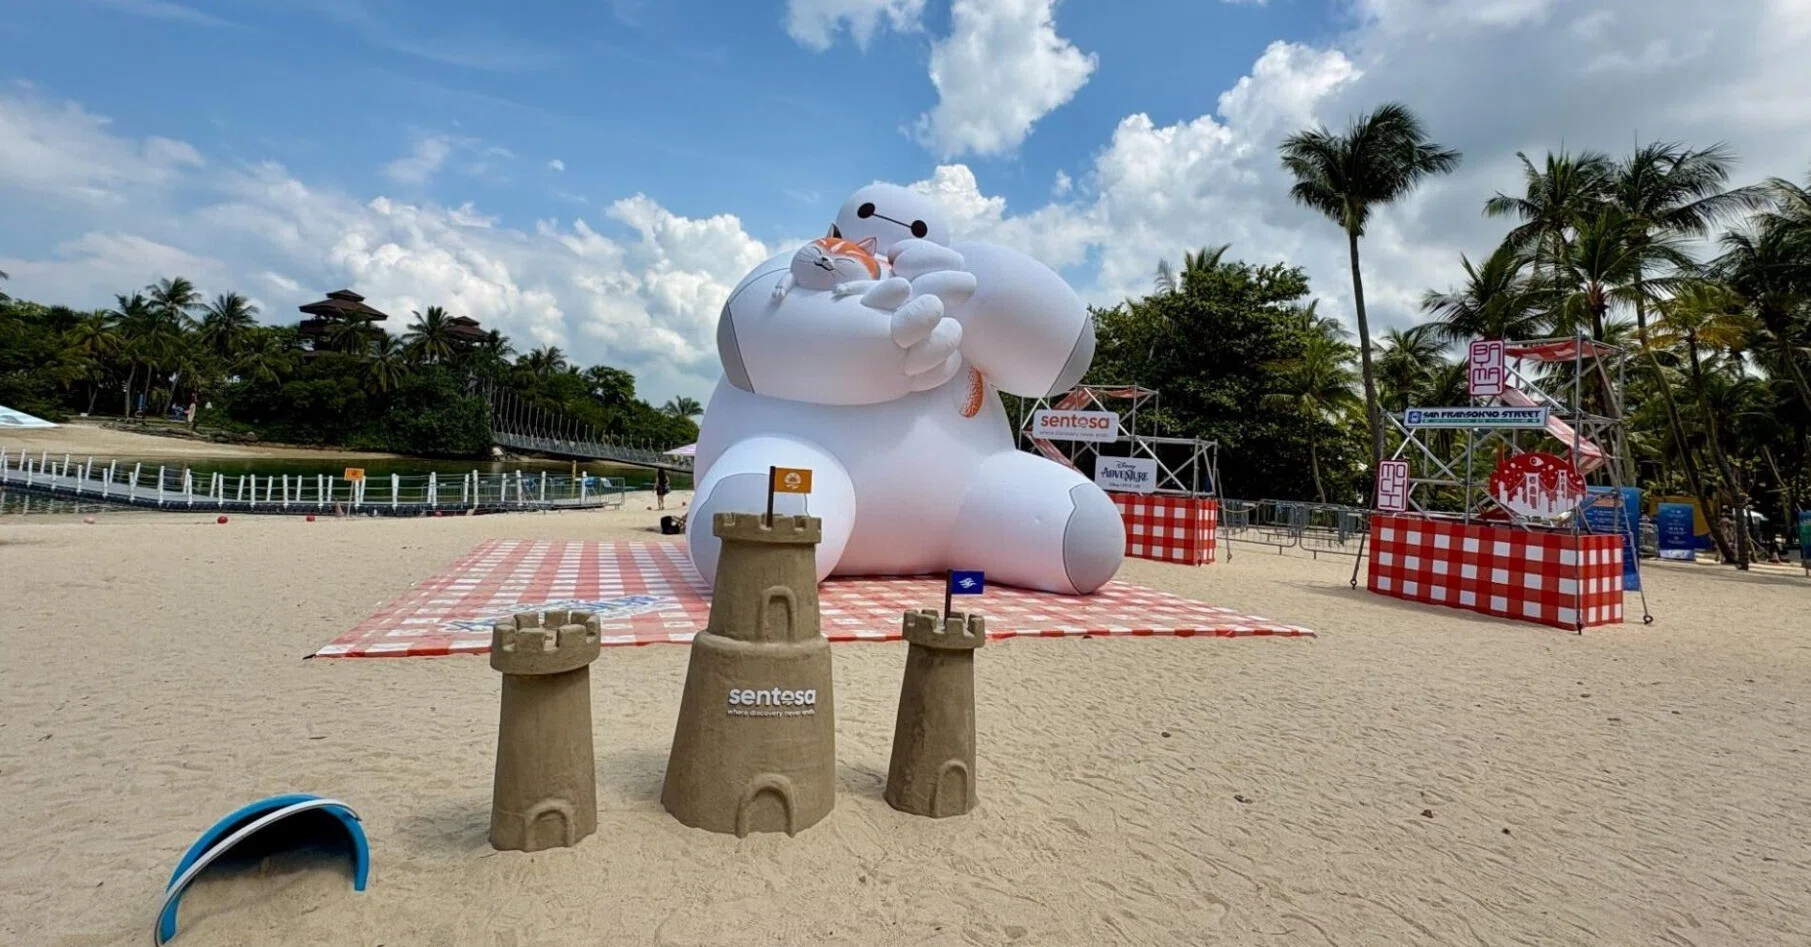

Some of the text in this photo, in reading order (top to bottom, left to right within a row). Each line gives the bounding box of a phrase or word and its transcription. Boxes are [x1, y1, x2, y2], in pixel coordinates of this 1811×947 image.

[1040, 414, 1110, 429] sentosa
[1502, 410, 1540, 418] STREET
[728, 687, 816, 705] sentosa
